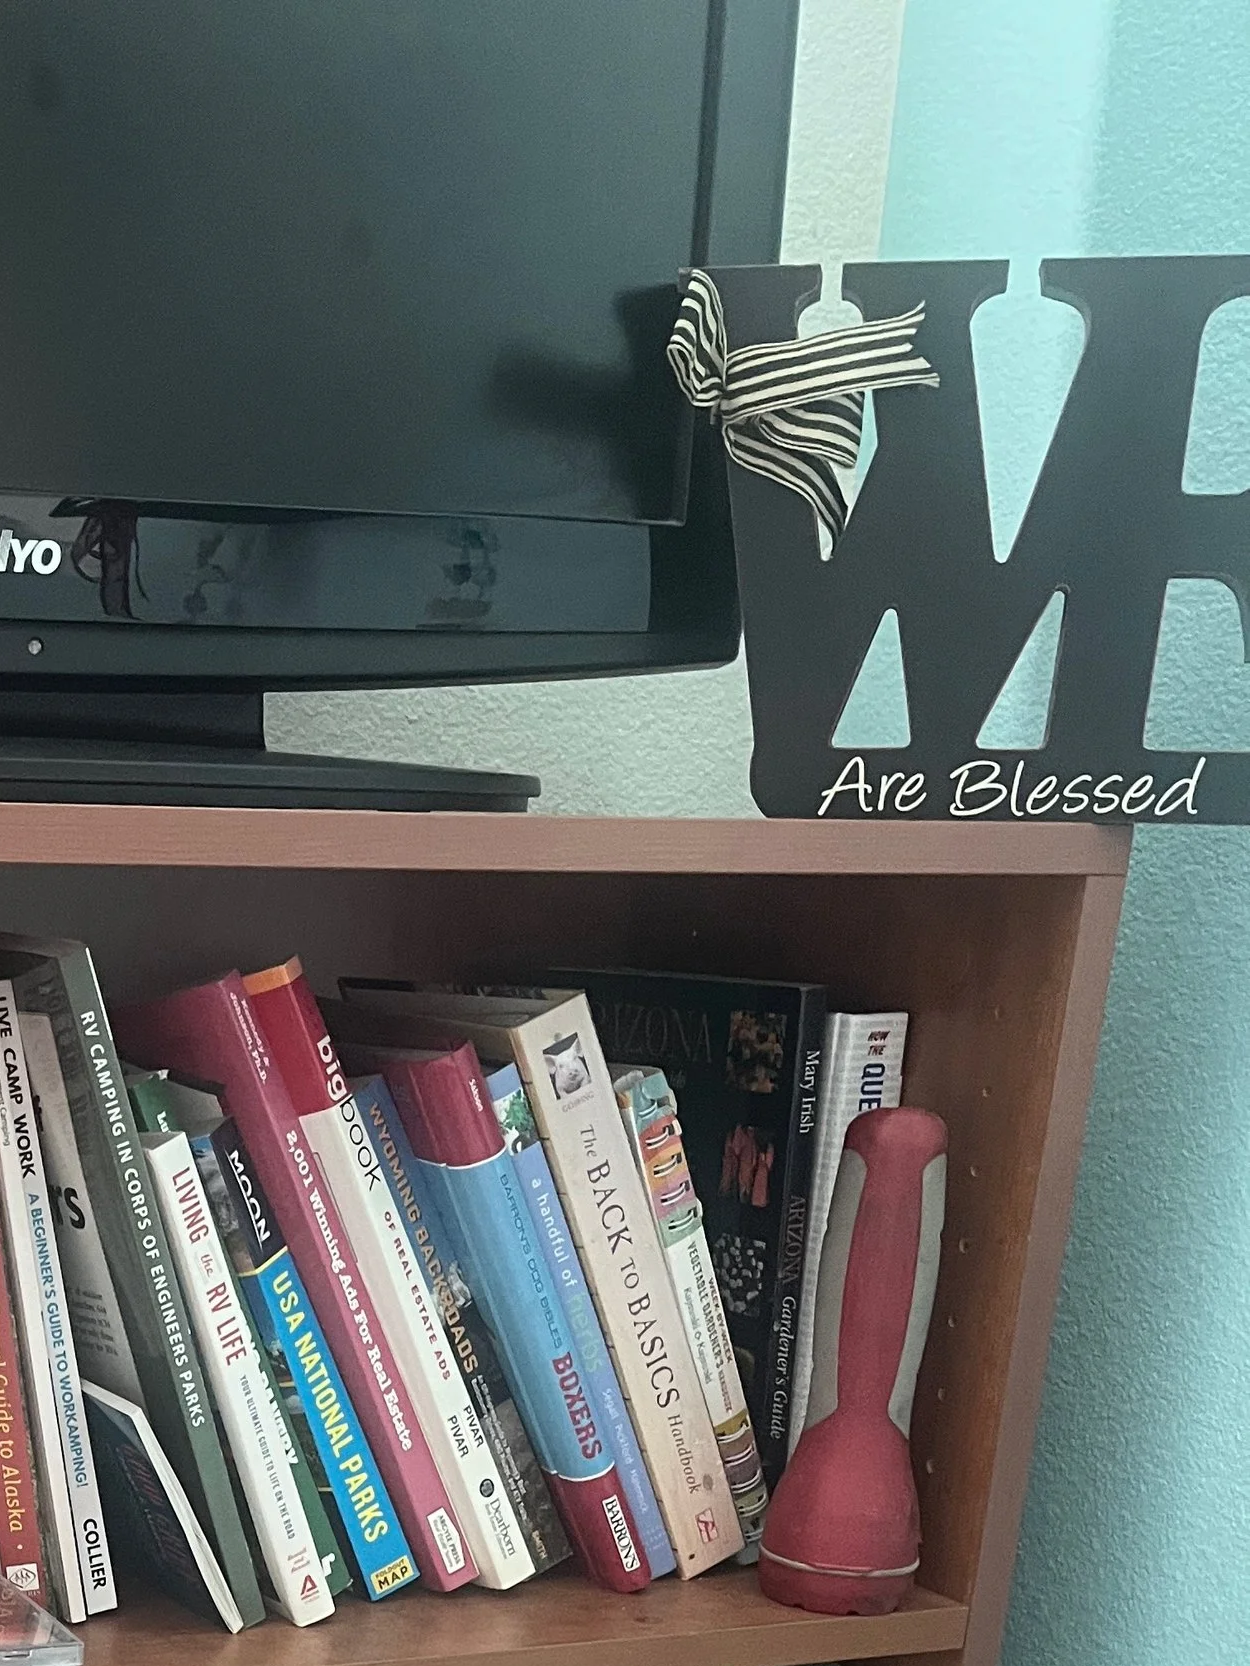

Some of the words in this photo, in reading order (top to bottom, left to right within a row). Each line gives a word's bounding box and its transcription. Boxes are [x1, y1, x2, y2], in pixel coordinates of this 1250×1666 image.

[817, 756, 927, 817] Are
[949, 756, 1207, 818] Blessed
[80, 1010, 100, 1037] RV
[867, 1030, 891, 1042] HOW
[800, 1050, 820, 1092] Mary
[867, 1044, 886, 1056] THE
[3, 1047, 24, 1105] CAMP
[90, 1044, 127, 1137] CAMPING
[859, 1062, 886, 1112] QUE
[800, 1096, 816, 1134] Irish
[13, 1113, 37, 1180] WORK
[116, 1140, 134, 1164] IN
[580, 1124, 598, 1158] The
[28, 1193, 40, 1205] A
[124, 1167, 152, 1231] CORPS
[172, 1166, 209, 1245] LIVING
[229, 1150, 271, 1243] MOON
[531, 1177, 542, 1189] a
[587, 1159, 634, 1256] BACK
[142, 1235, 161, 1260] OF
[369, 1102, 422, 1224] WYOMING
[415, 1226, 479, 1375] BACKROADS
[536, 1192, 570, 1264] handful
[31, 1207, 56, 1300] BEGINNER'S
[200, 1254, 214, 1277] the
[500, 1174, 532, 1255] BARRON'S
[528, 1258, 544, 1294] DOG
[540, 1296, 562, 1349] BIBLES
[561, 1269, 578, 1288] of
[620, 1257, 640, 1289] TO
[206, 1281, 232, 1314] RV
[286, 1130, 313, 1188] 2,001
[309, 1187, 346, 1274] Winning
[339, 1274, 360, 1312] Ads
[354, 1309, 374, 1346] For
[367, 1344, 392, 1391] Real
[383, 1388, 413, 1451] Estate
[384, 1211, 396, 1230] OF
[393, 1237, 412, 1281] REAL
[410, 1284, 438, 1345] ESTATE
[434, 1350, 451, 1381] ADS
[46, 1302, 65, 1348] GUIDE
[150, 1264, 189, 1368] ENGINEERS
[568, 1292, 603, 1374] herbs
[55, 1350, 68, 1373] TO
[216, 1316, 247, 1367] LIFE
[627, 1292, 680, 1408] BASICS
[775, 1296, 796, 1388] Gardener's
[179, 1369, 206, 1428] PARKS
[237, 1374, 252, 1396] YOUR
[272, 1270, 306, 1334] USA
[294, 1331, 355, 1459] NATIONAL
[339, 1453, 389, 1544] PARKS
[552, 1351, 603, 1461] BOXERS
[59, 1375, 89, 1488] WORKAMPING!
[244, 1397, 265, 1434] ULTIMATE
[447, 1415, 470, 1458] PIVAR
[463, 1405, 484, 1448] PIVAR
[770, 1390, 788, 1441] Guide
[256, 1435, 272, 1459] GUIDE
[264, 1460, 276, 1471] TO
[667, 1414, 702, 1494] Handbook
[2, 1464, 26, 1533] Alaska
[267, 1471, 281, 1489] LIFE
[273, 1490, 284, 1502] ON
[277, 1502, 290, 1518] THE
[281, 1518, 297, 1539] ROAD
[491, 1498, 516, 1556] Dearborn
[605, 1499, 640, 1570] BARRON'S
[83, 1518, 107, 1591] COLLIER
[375, 1558, 405, 1579] FOLDOUT
[377, 1565, 409, 1592] MAP
